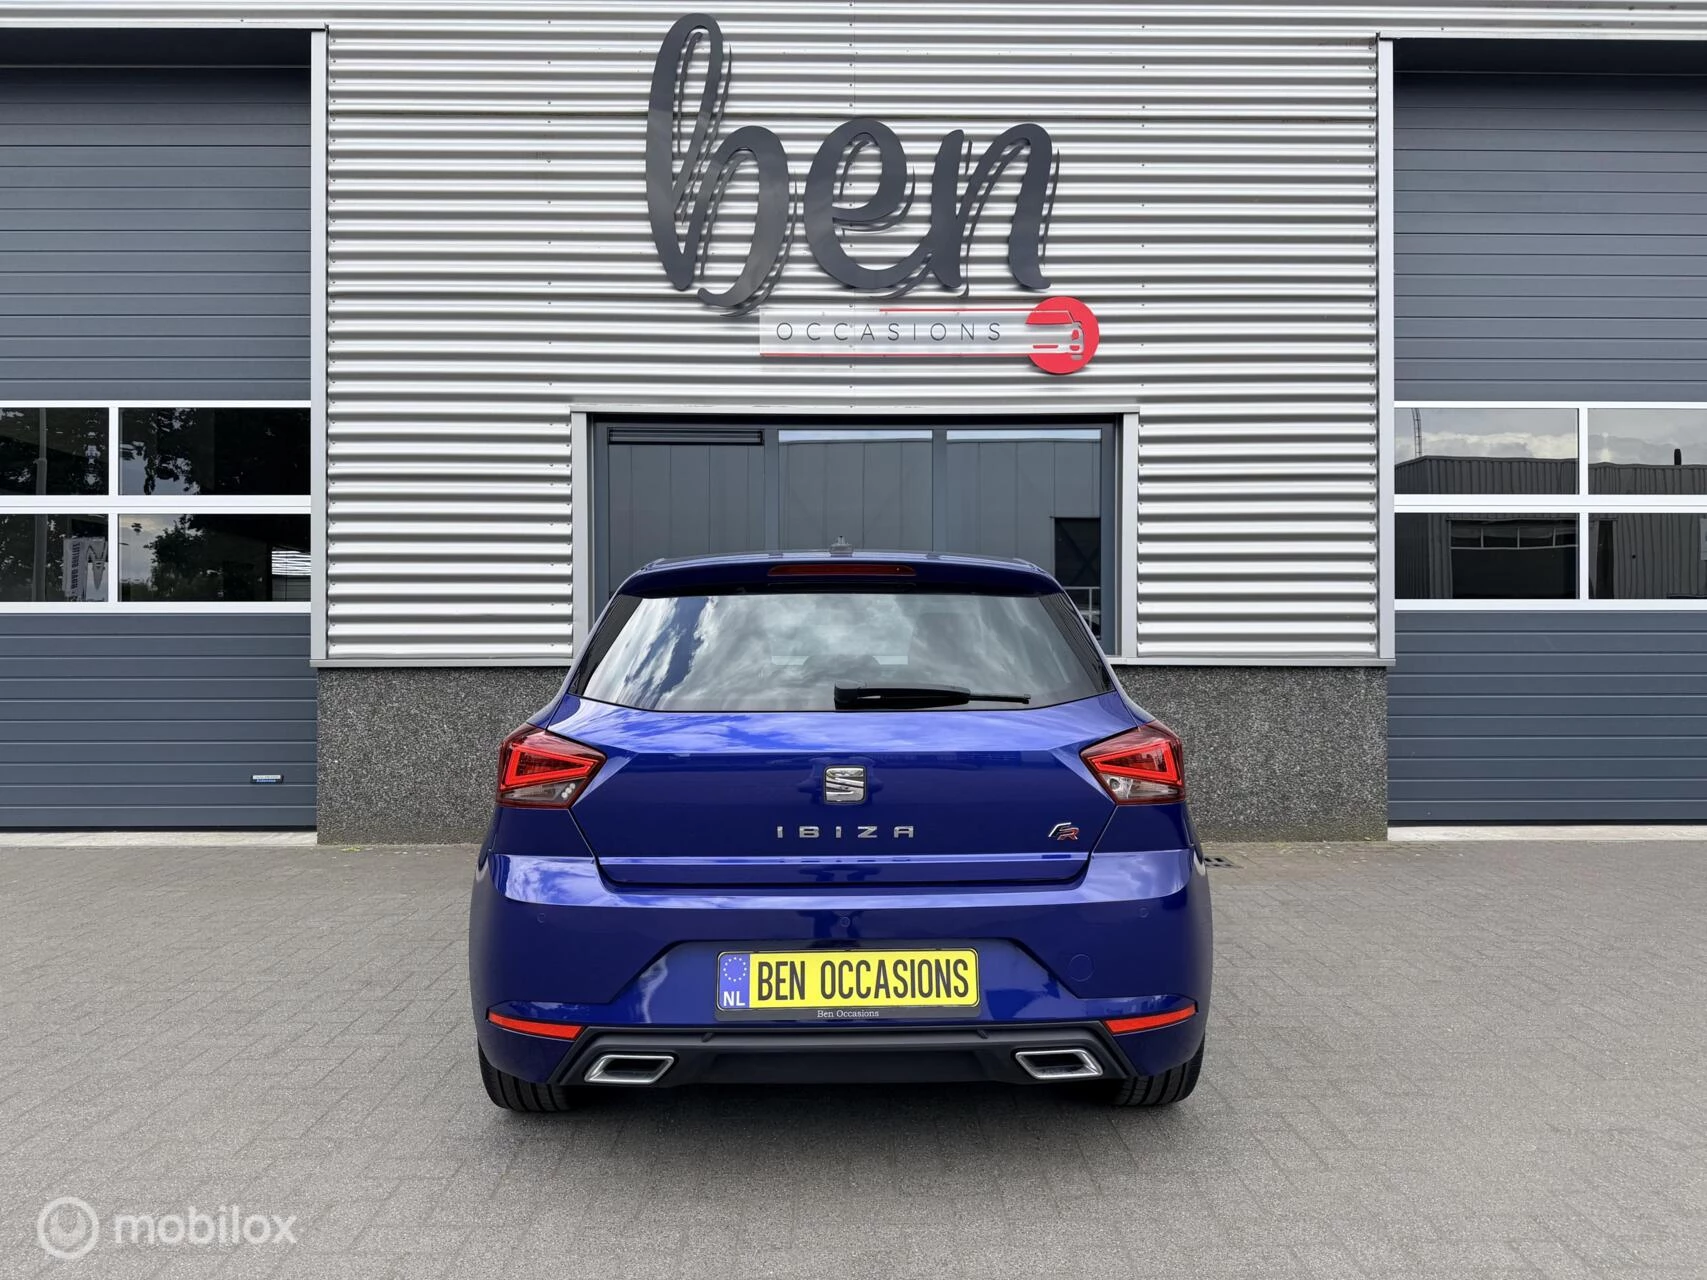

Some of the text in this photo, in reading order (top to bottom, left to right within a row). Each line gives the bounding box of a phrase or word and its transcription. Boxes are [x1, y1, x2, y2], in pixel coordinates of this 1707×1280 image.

[645, 12, 1054, 308] ben
[775, 321, 1001, 342] OCCASIONS
[776, 825, 915, 839] IBIZA
[757, 958, 969, 1001] BEN OCCASIONS
[723, 991, 745, 1007] NL
[816, 1009, 880, 1018] Ben Occasions
